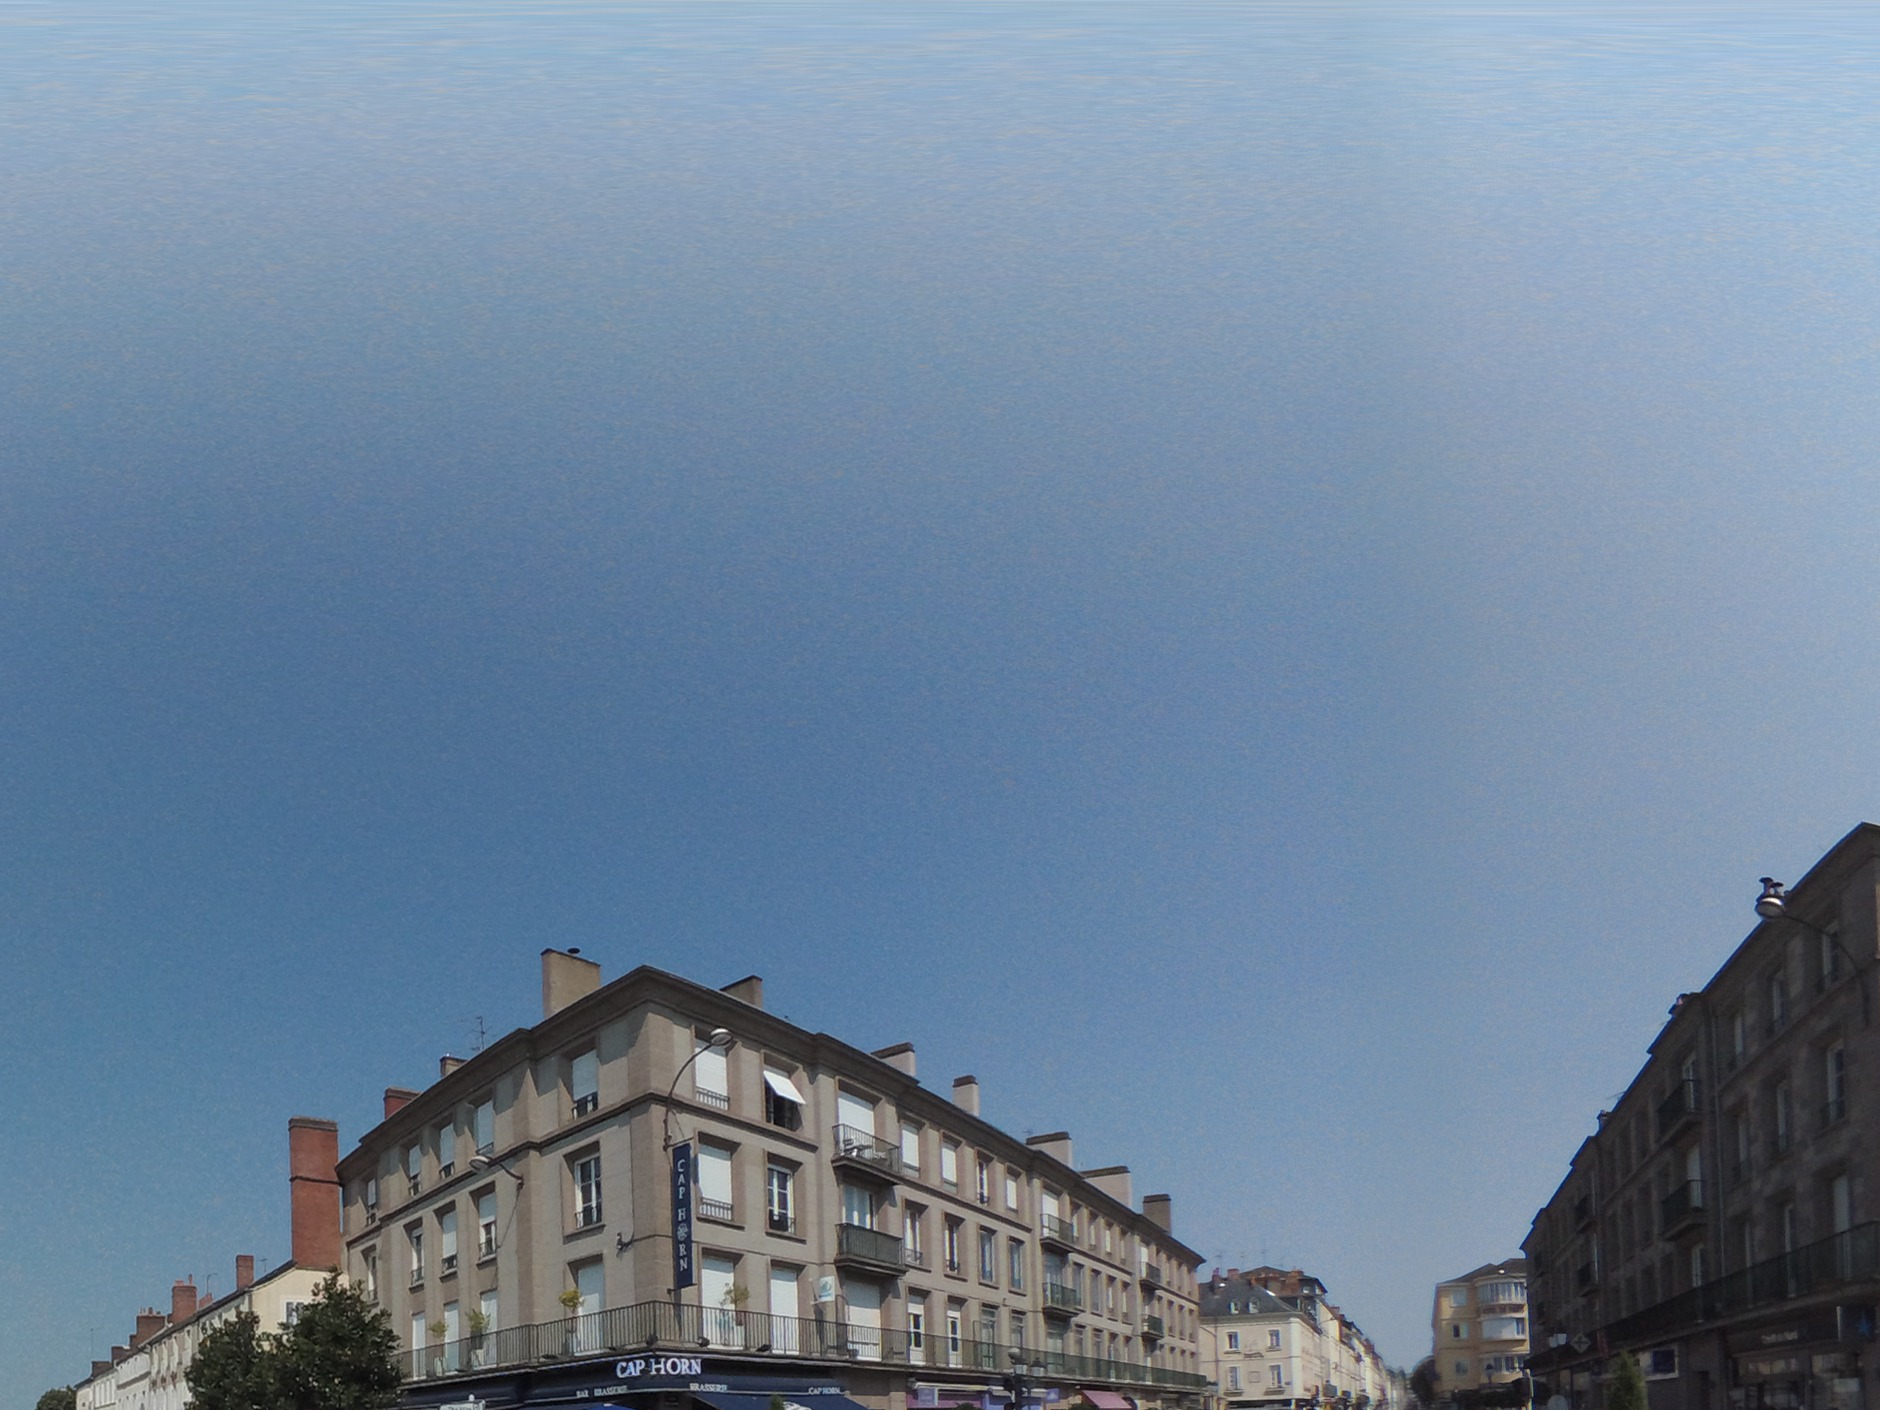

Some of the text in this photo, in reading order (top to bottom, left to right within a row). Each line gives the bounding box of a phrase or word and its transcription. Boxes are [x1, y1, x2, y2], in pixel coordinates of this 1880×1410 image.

[676, 1159, 687, 1200] CAP
[616, 1357, 702, 1379] CAP HORN
[808, 1386, 821, 1395] CAP
